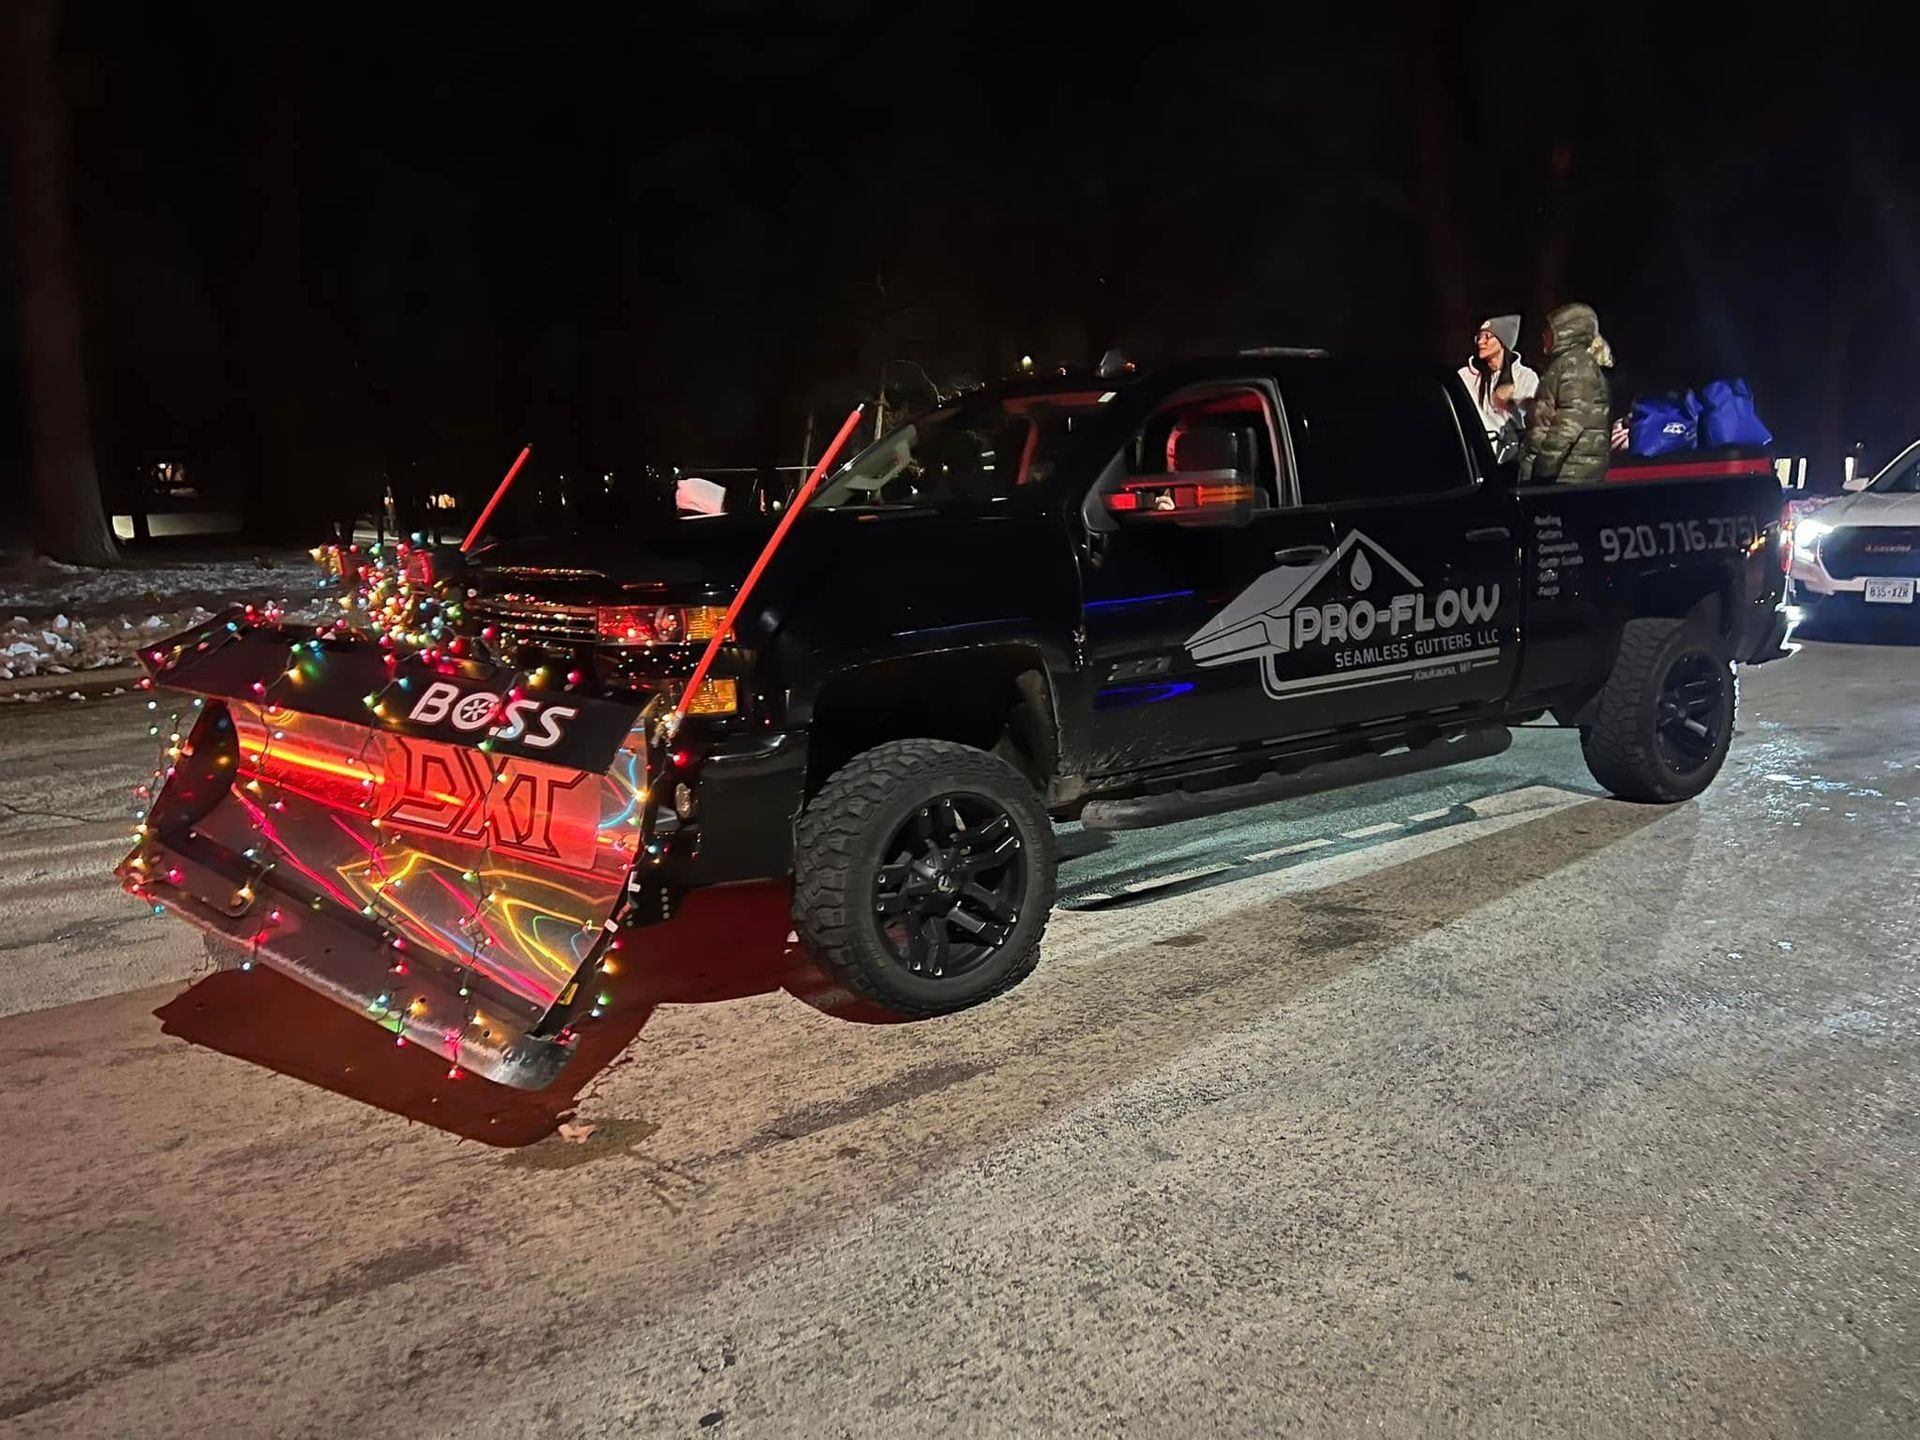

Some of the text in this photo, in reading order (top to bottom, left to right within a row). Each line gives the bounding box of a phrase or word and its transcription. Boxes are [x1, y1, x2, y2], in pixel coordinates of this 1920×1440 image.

[1294, 584, 1500, 649] PRO-FLOW
[1335, 629, 1499, 669] SEAMLESS GUTTERS LLC
[408, 681, 579, 748] BOSS
[382, 736, 591, 859] DXT
